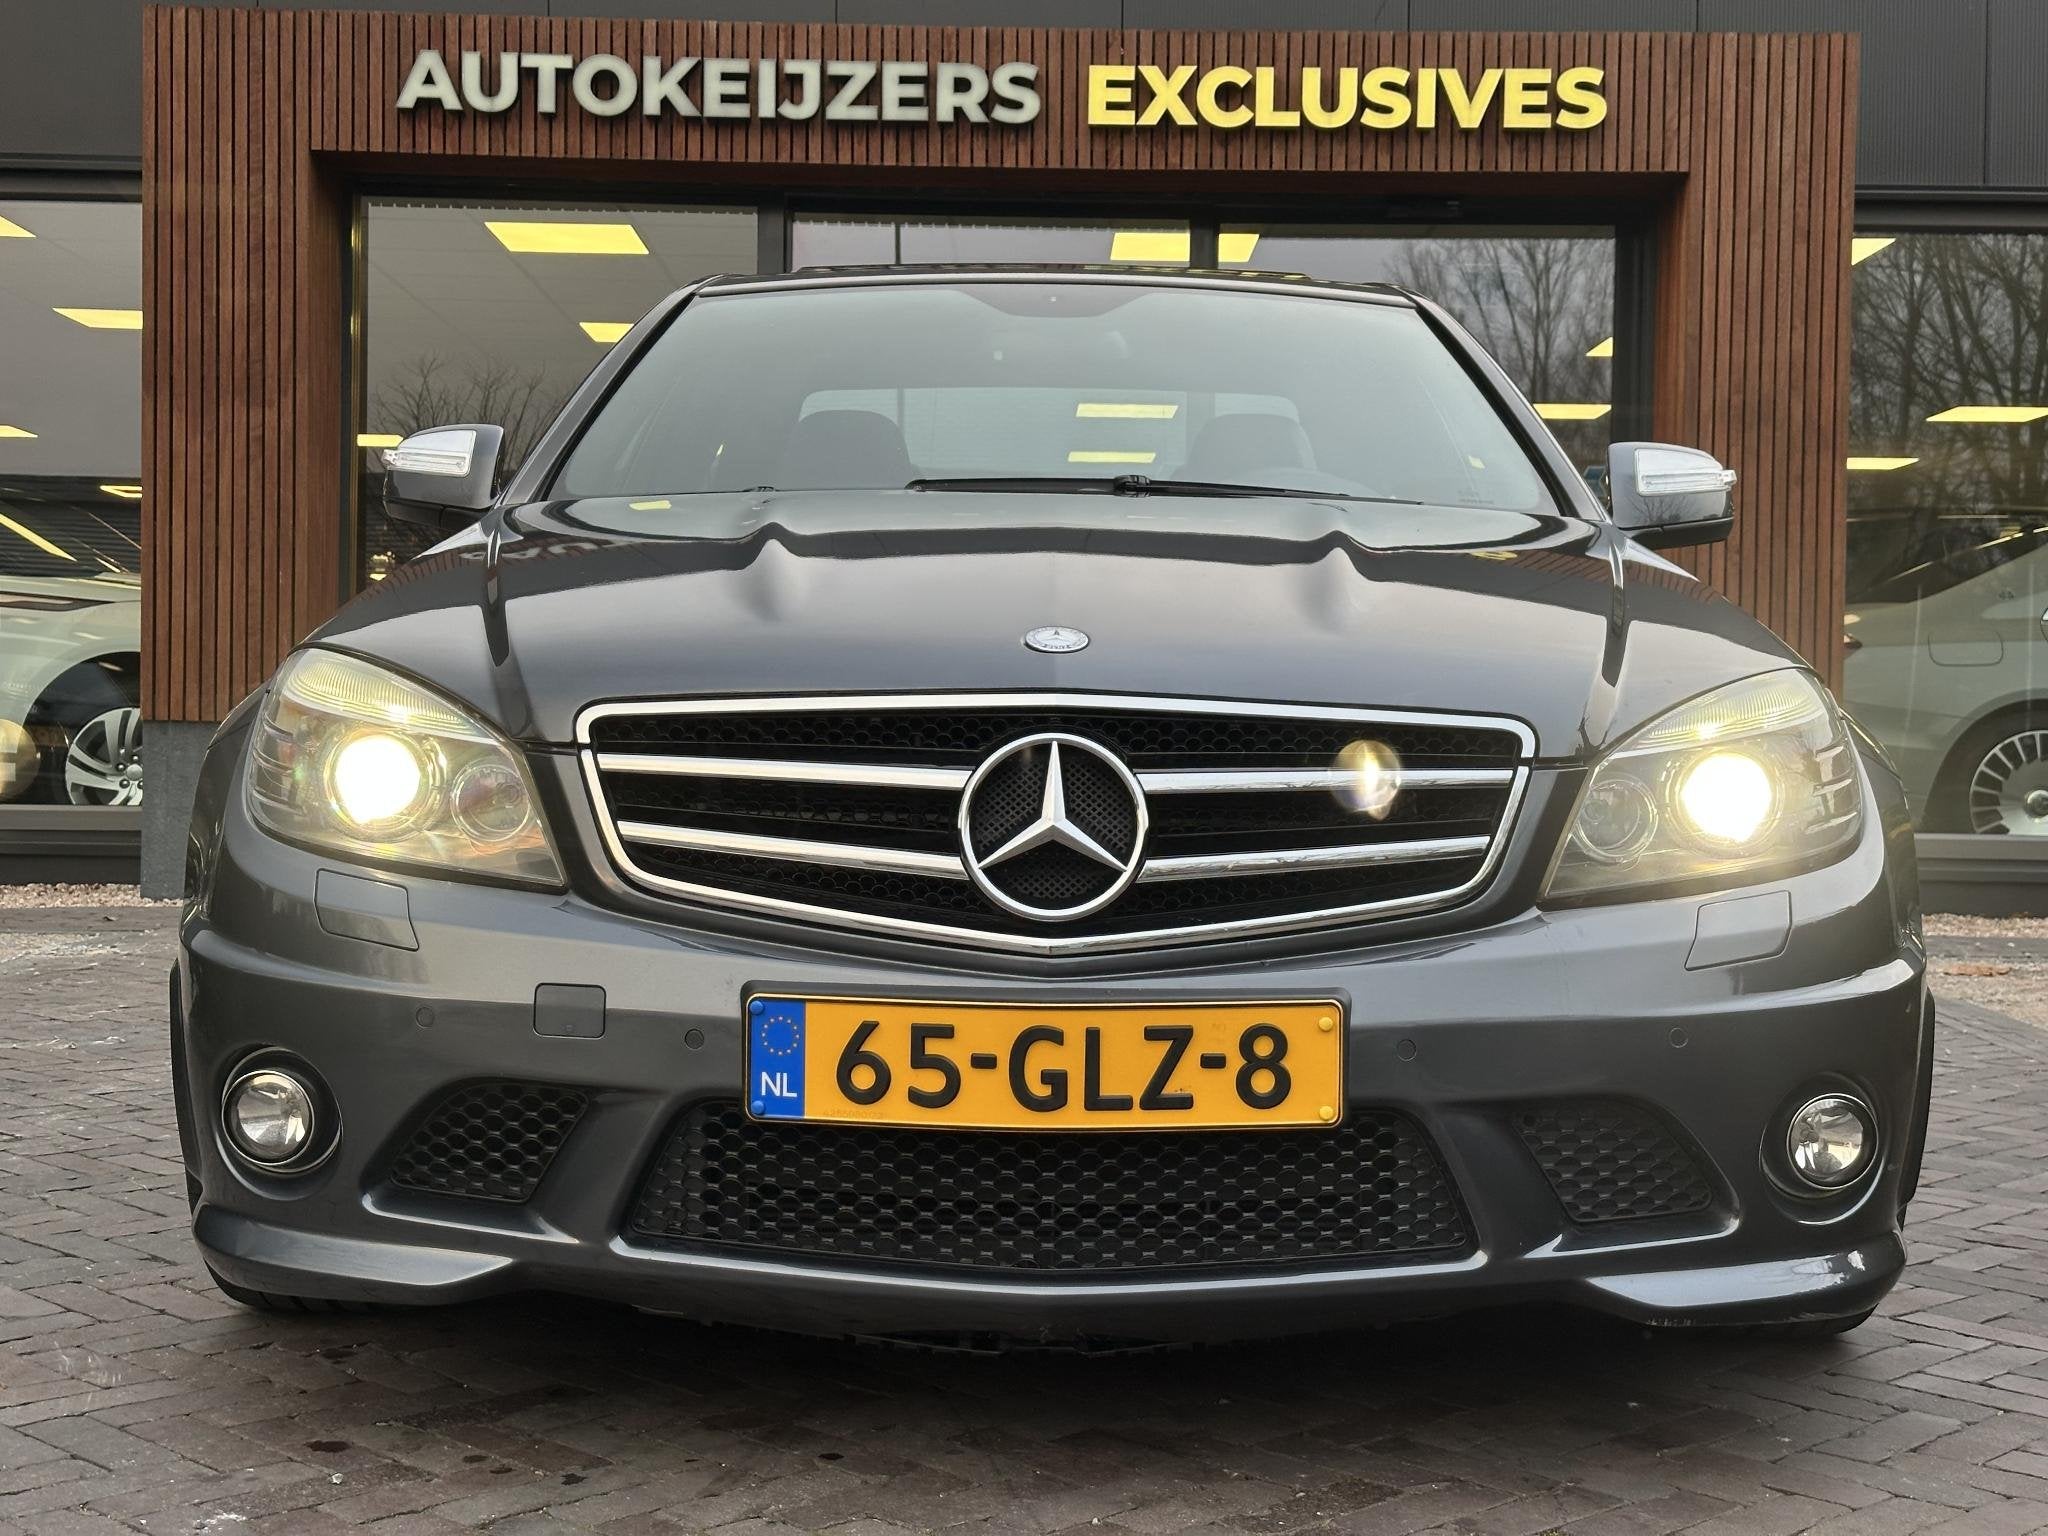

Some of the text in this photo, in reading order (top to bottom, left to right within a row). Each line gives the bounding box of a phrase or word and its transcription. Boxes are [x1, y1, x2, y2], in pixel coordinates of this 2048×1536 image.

[396, 49, 1608, 128] AUTOKEIJZERS EXCLUSIVES
[761, 1071, 798, 1098] NL
[836, 1020, 1292, 1111] 65-GLZ-8
